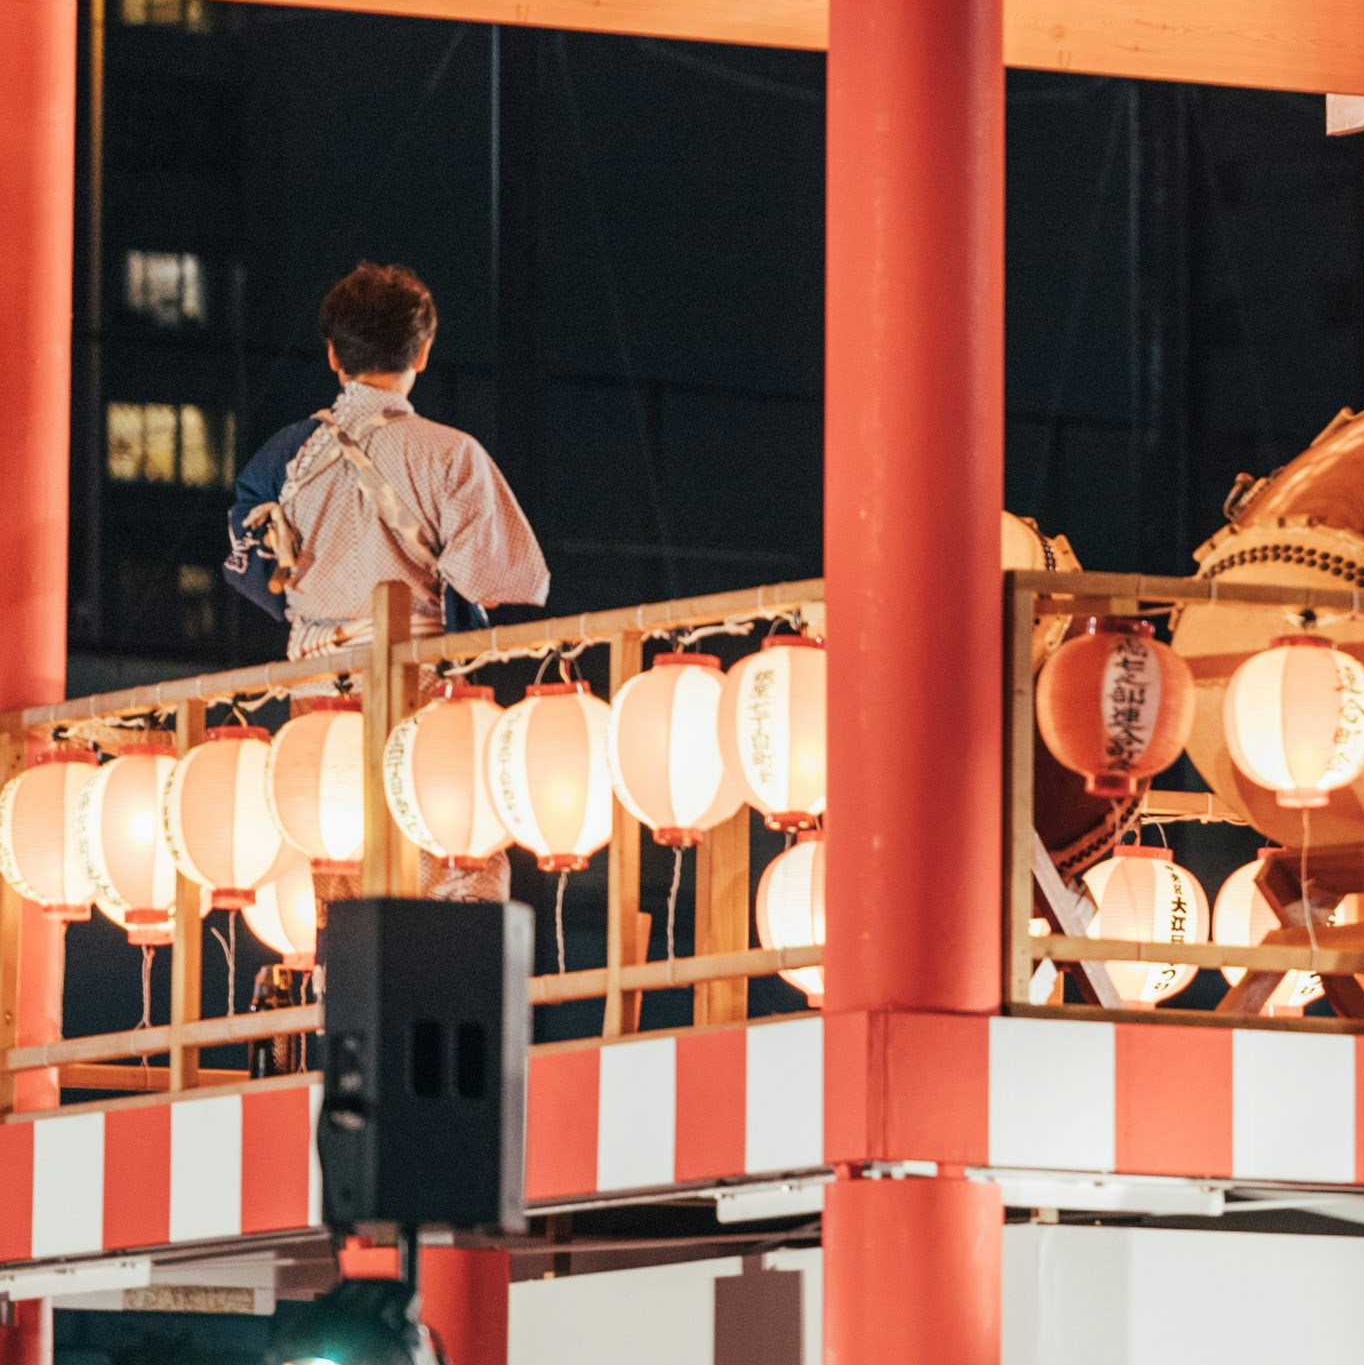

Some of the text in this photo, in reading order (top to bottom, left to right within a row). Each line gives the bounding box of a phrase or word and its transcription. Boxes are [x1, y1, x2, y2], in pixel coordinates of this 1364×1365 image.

[1153, 896, 1188, 991] 大江戸つり
